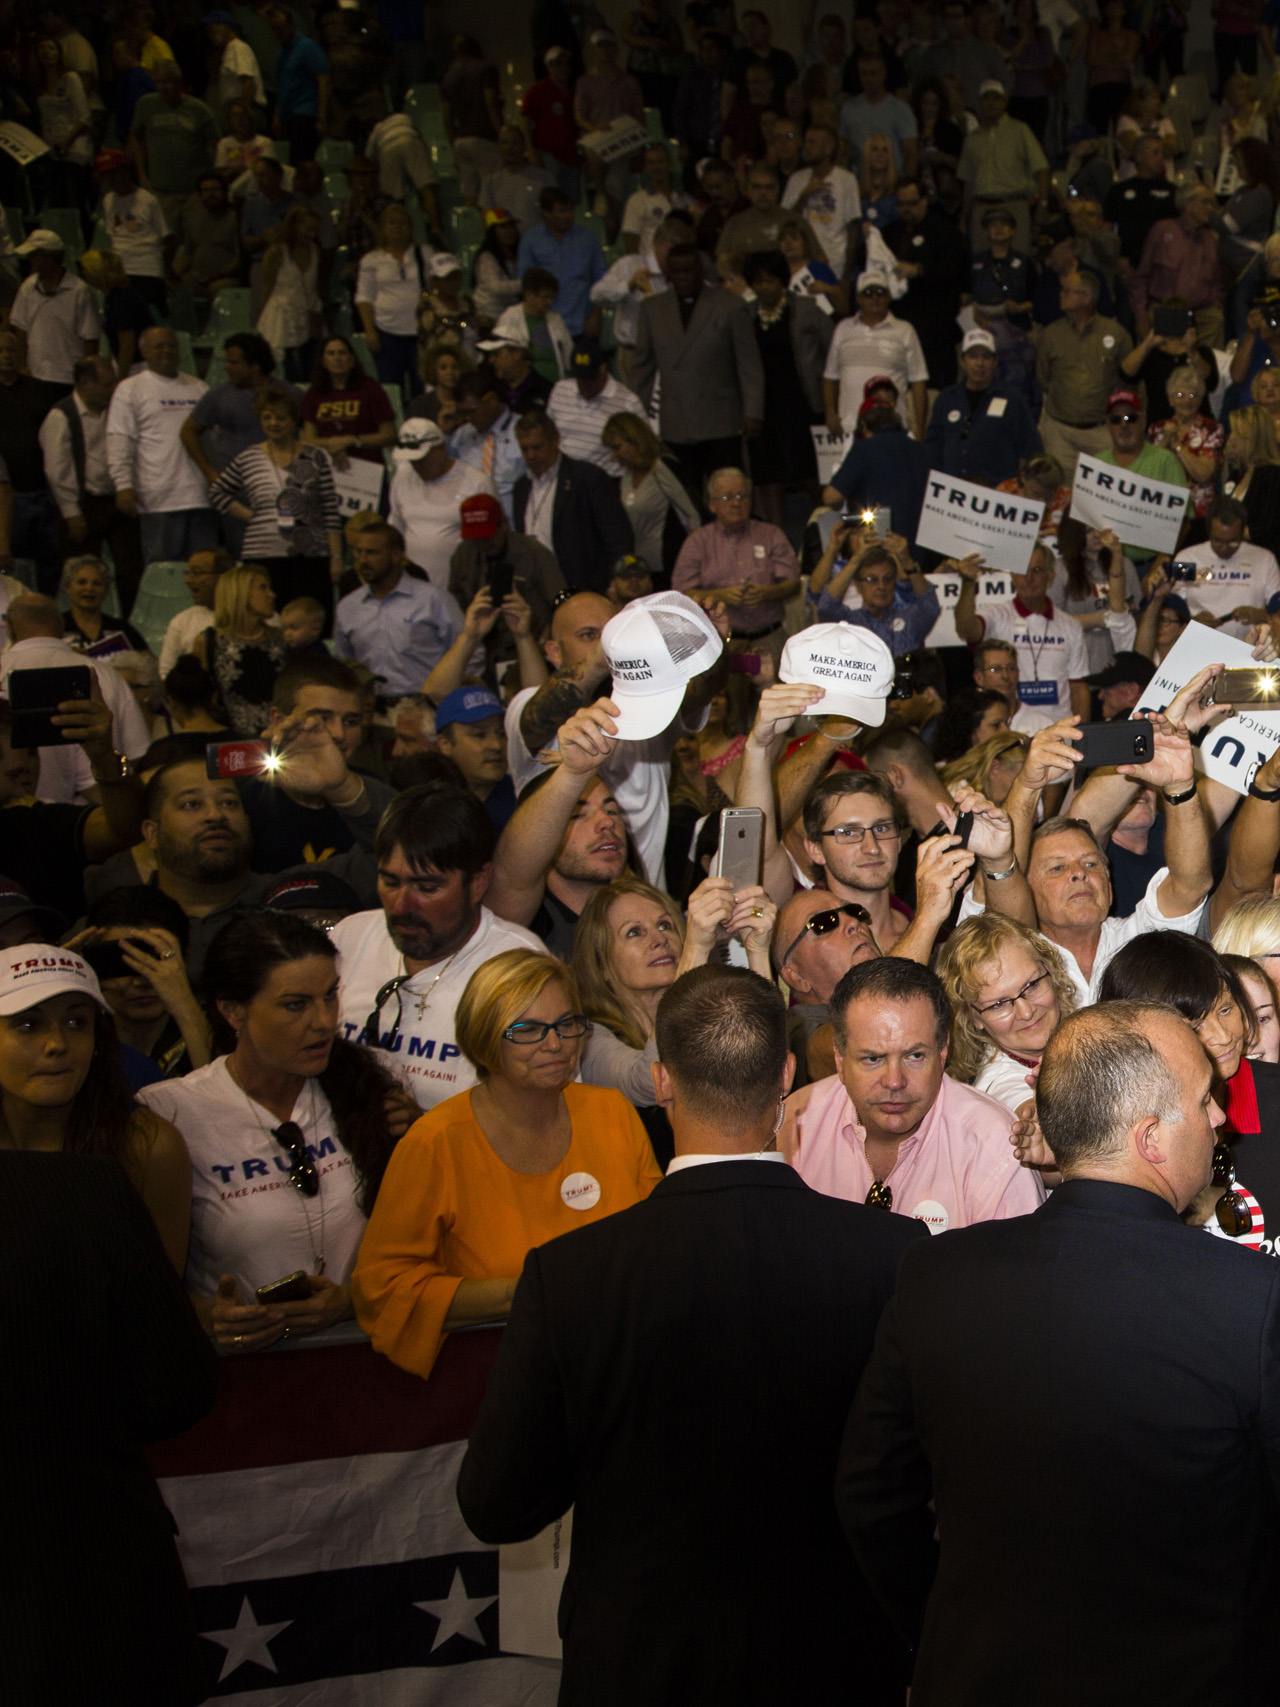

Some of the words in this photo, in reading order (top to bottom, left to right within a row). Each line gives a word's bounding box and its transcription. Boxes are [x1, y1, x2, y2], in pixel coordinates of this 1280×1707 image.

[316, 399, 360, 420] FSU
[1079, 463, 1186, 508] TRUMP
[930, 481, 1040, 525] TRUMP
[613, 658, 650, 670] AMERICA
[809, 653, 837, 666] MAKE
[837, 658, 877, 672] AMERICA
[622, 669, 653, 681] AGAIN
[812, 665, 843, 679] GREAT
[844, 672, 872, 683] AGAIN
[10, 957, 85, 972] TRUMP
[423, 1069, 457, 1083] AGAIN!
[211, 1136, 337, 1184] TRUM
[251, 1181, 293, 1195] AMERIC
